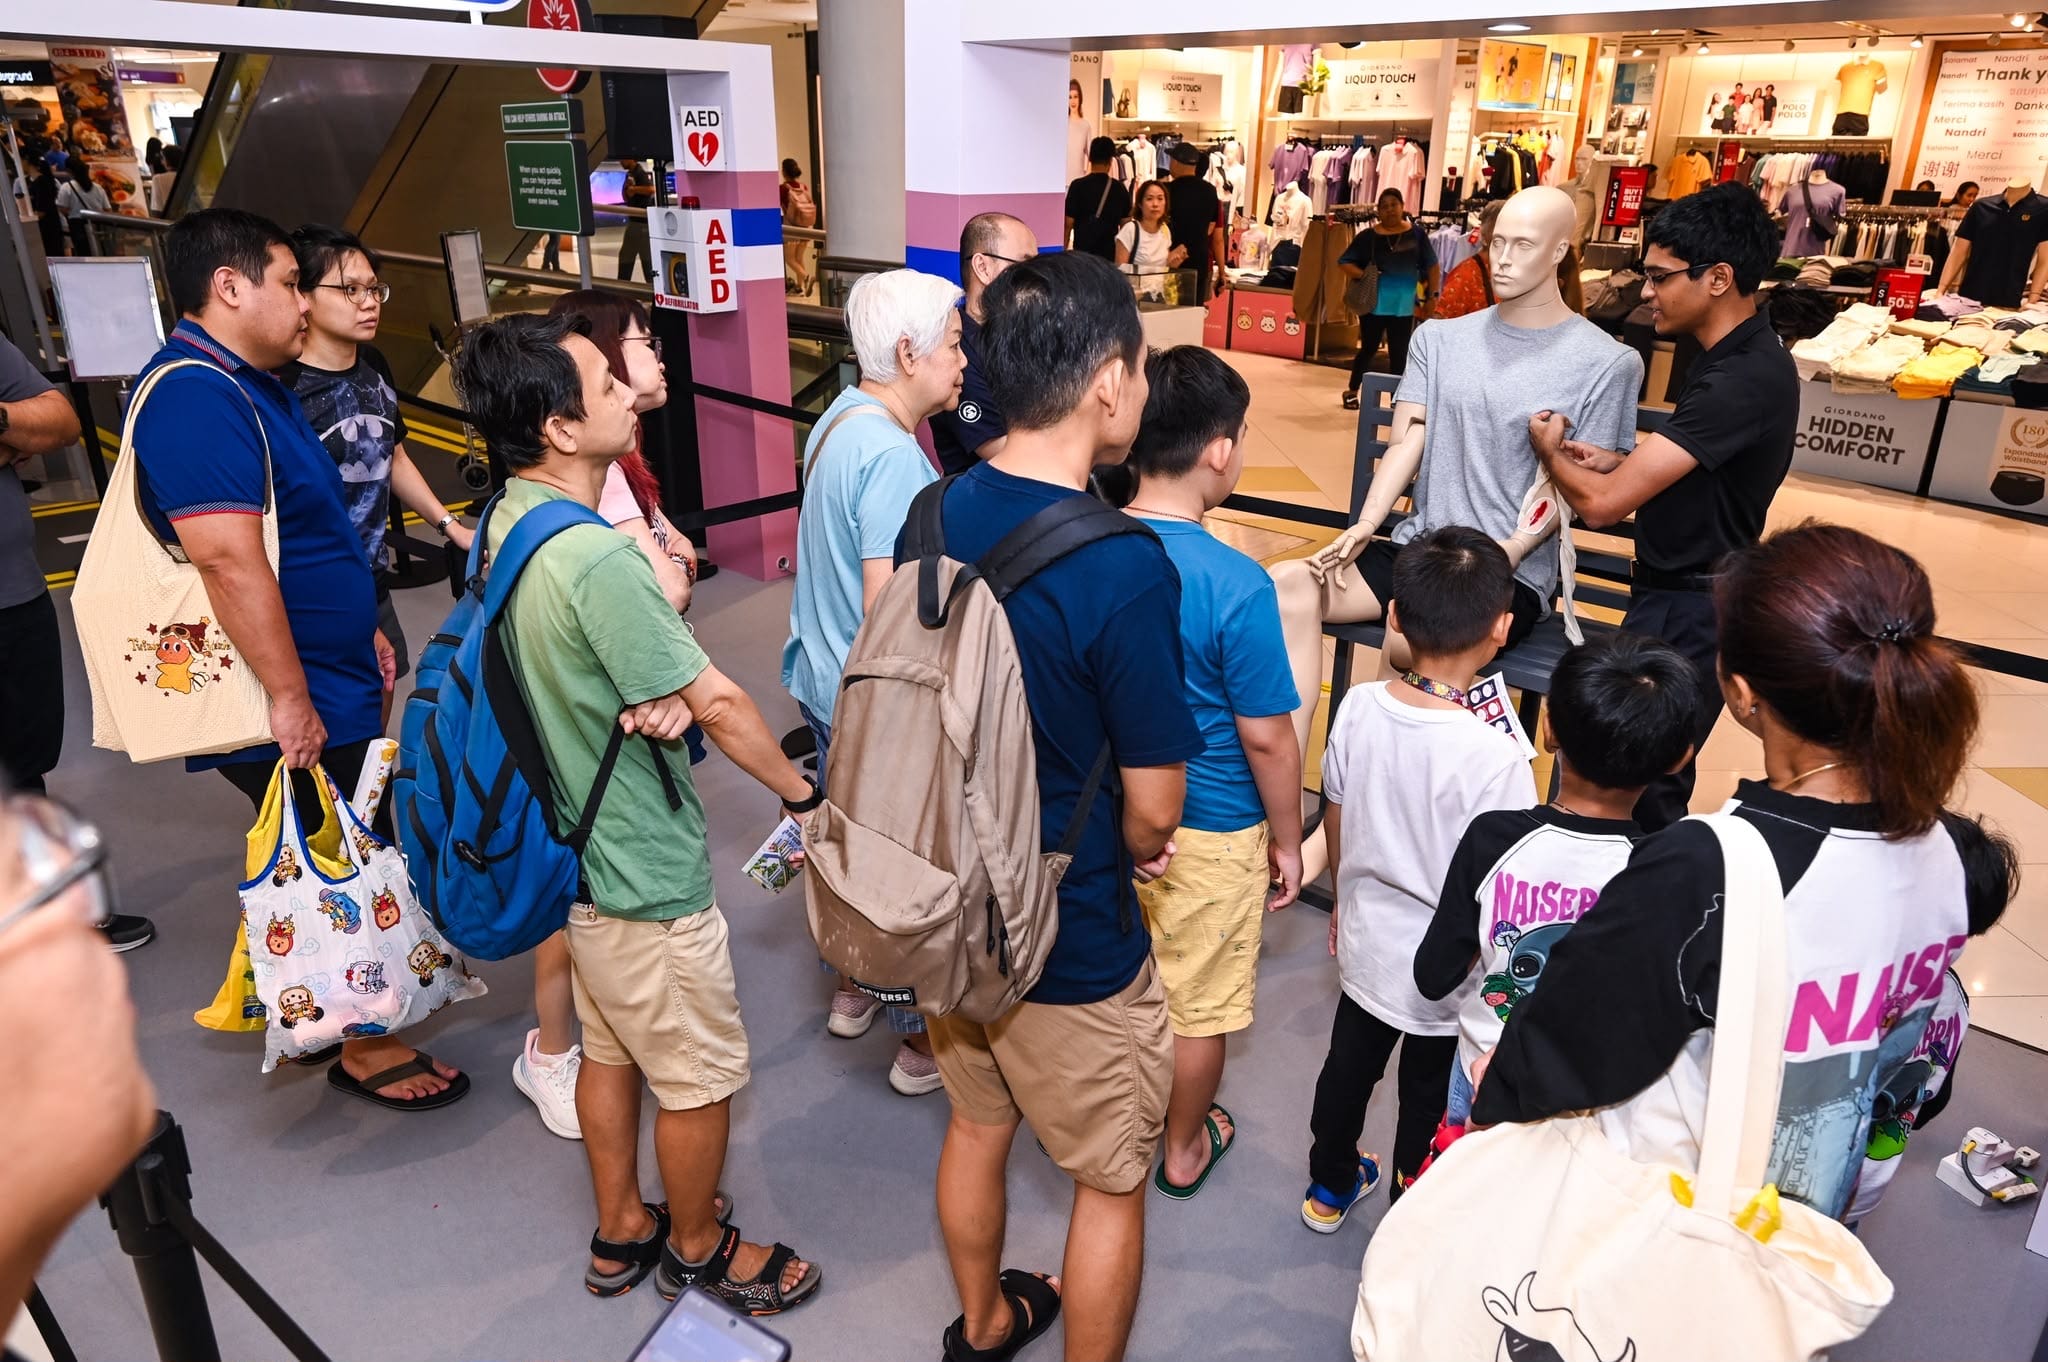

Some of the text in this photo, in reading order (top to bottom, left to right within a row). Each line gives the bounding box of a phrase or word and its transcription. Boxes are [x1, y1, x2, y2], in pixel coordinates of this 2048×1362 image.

[1071, 54, 1098, 64] DANO
[1994, 55, 2028, 63] Nandri
[1345, 73, 1415, 85] LIQUID TOUCH
[1976, 68, 2031, 80] Thank
[1163, 82, 1202, 92] LIQUID TOUCH
[684, 110, 719, 126] AED
[1934, 116, 1967, 124] Merci
[1945, 128, 1986, 136] Nandri
[1966, 150, 2002, 160] Merci
[1608, 182, 1619, 217] SALE
[706, 219, 730, 304] AED
[665, 297, 699, 310] DEFIBRILLATOR
[1888, 297, 1905, 308] 50
[1824, 406, 1885, 421] GIORDANO
[1808, 416, 1894, 444] HIDDEN
[2023, 425, 2045, 437] 180
[1794, 432, 1905, 465] COMFORT
[2004, 454, 2047, 465] Waistband
